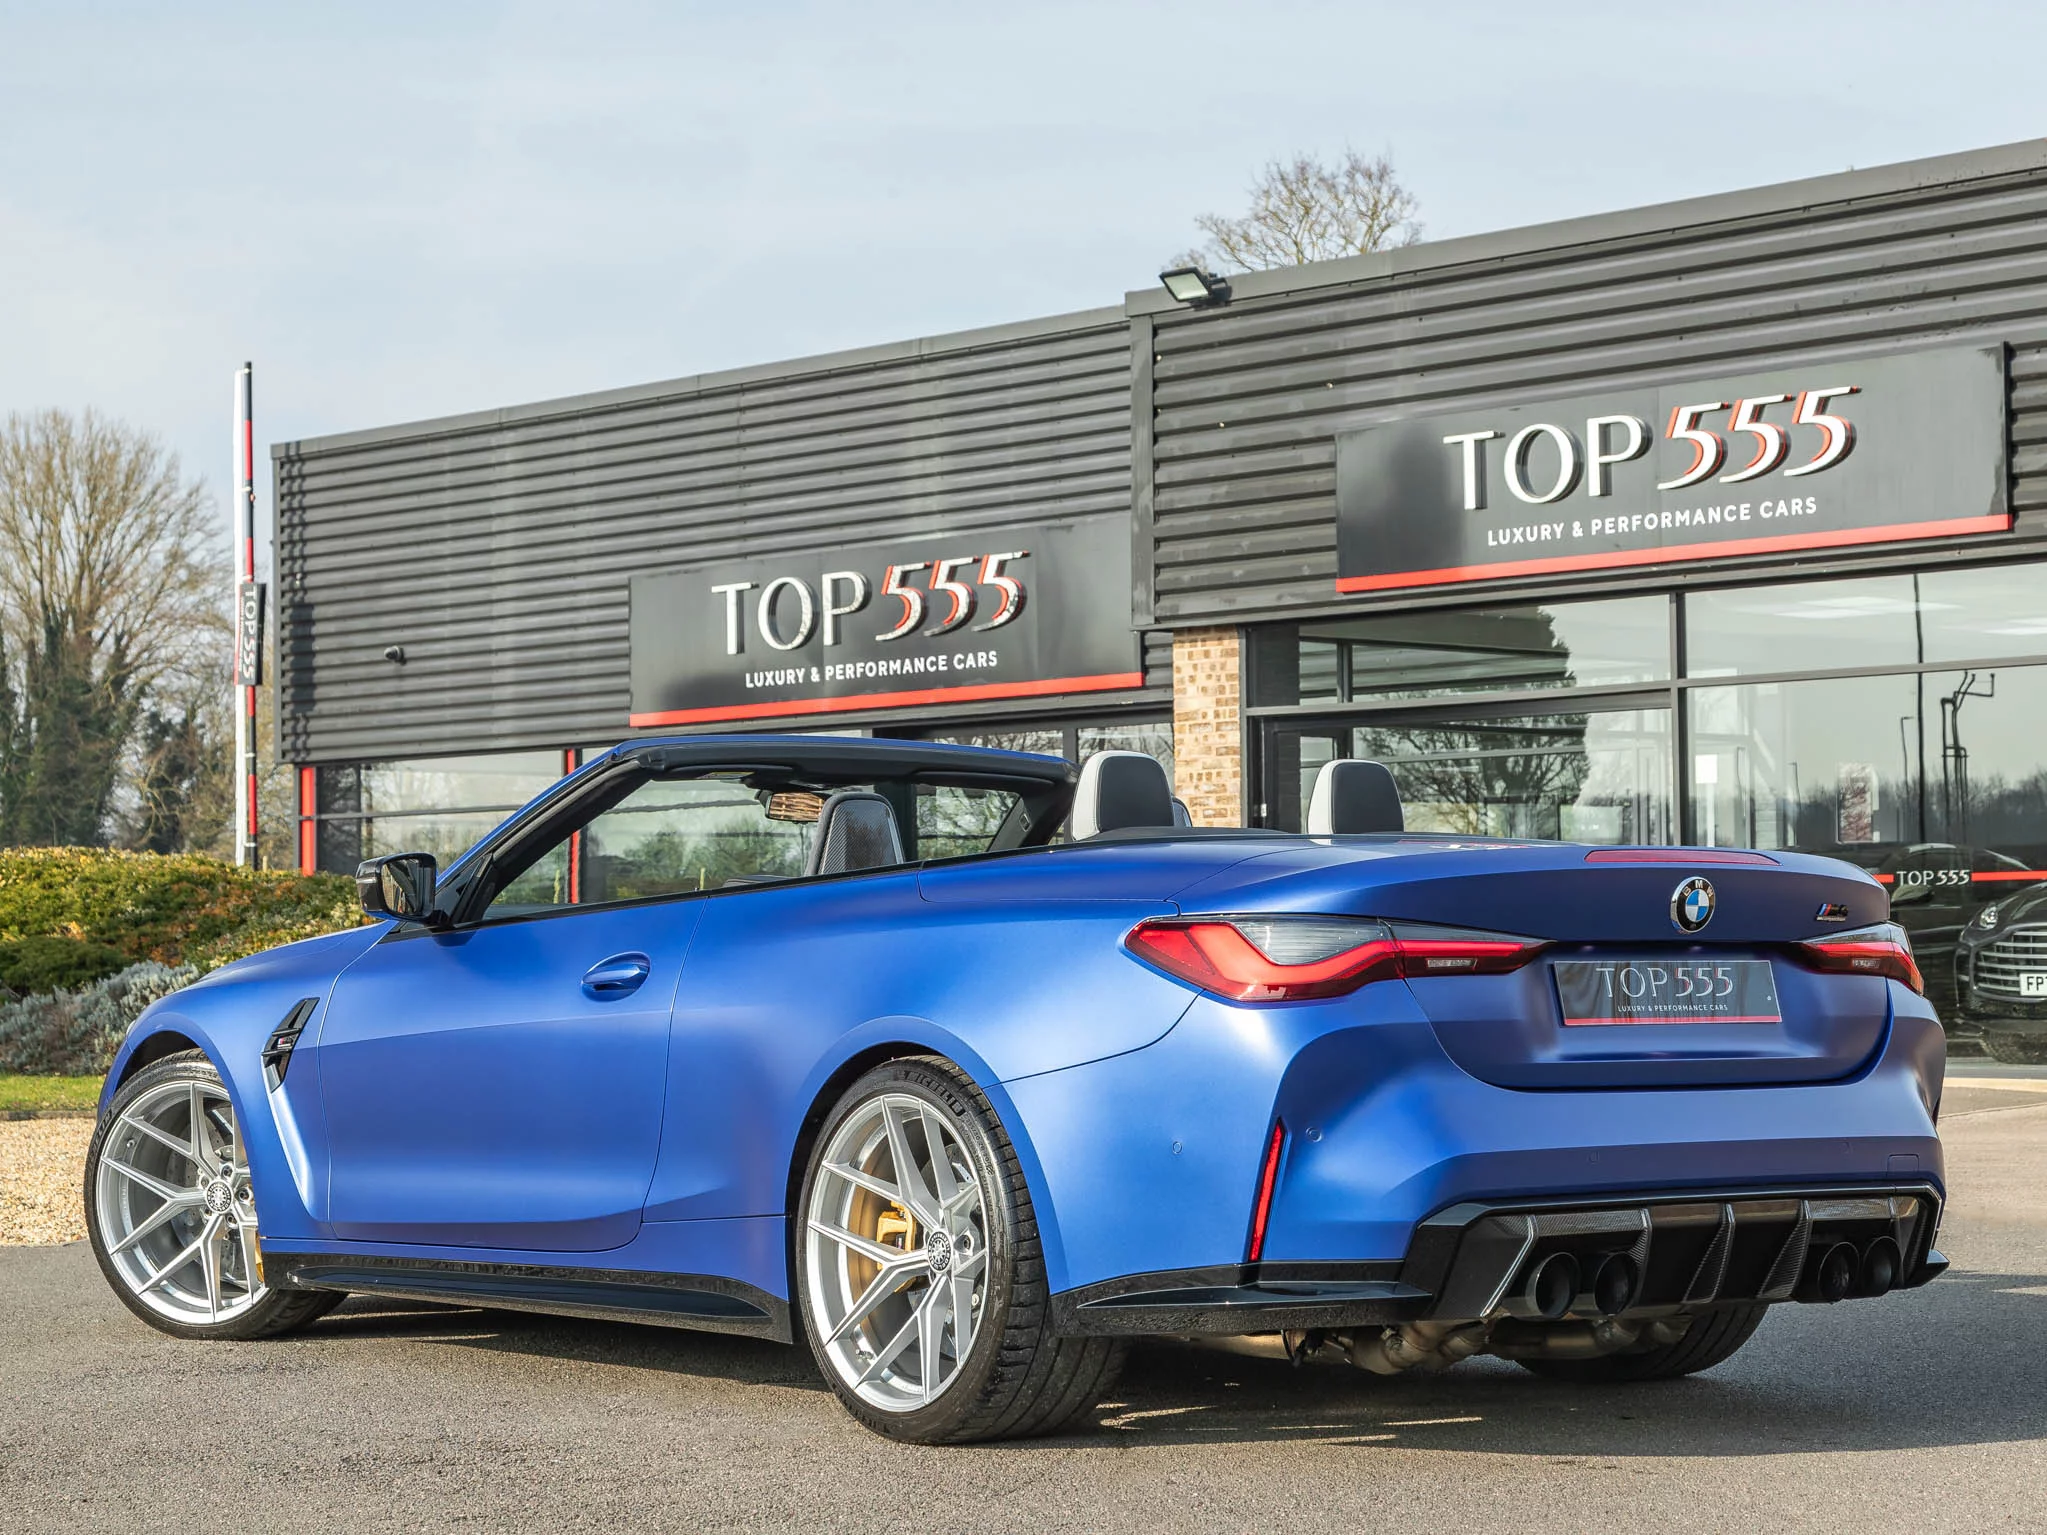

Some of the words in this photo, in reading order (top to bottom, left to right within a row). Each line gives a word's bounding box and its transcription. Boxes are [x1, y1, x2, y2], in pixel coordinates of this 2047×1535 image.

[1443, 415, 1651, 510] TOP
[1657, 385, 1862, 490] 555
[1487, 521, 1564, 546] LUXURY
[1572, 520, 1584, 538] &
[1591, 504, 1753, 536] PERFORMANCE
[1760, 496, 1817, 519] CARS
[245, 586, 257, 635] TOP
[711, 570, 872, 655] TOP
[875, 550, 1031, 642] 555
[745, 667, 805, 690] LUXURY
[810, 667, 821, 683] &
[825, 653, 948, 681] PERFORMANCE
[953, 650, 998, 671] CARS
[1682, 879, 1714, 897] BMW
[1896, 870, 1935, 887] TOP
[1935, 869, 1971, 886] 555
[1595, 967, 1668, 998] TOP
[1674, 967, 1734, 997] 555
[2026, 975, 2047, 992] FP
[1654, 1004, 1708, 1012] PERFORMANCE
[905, 1071, 963, 1115] MICHELIN
